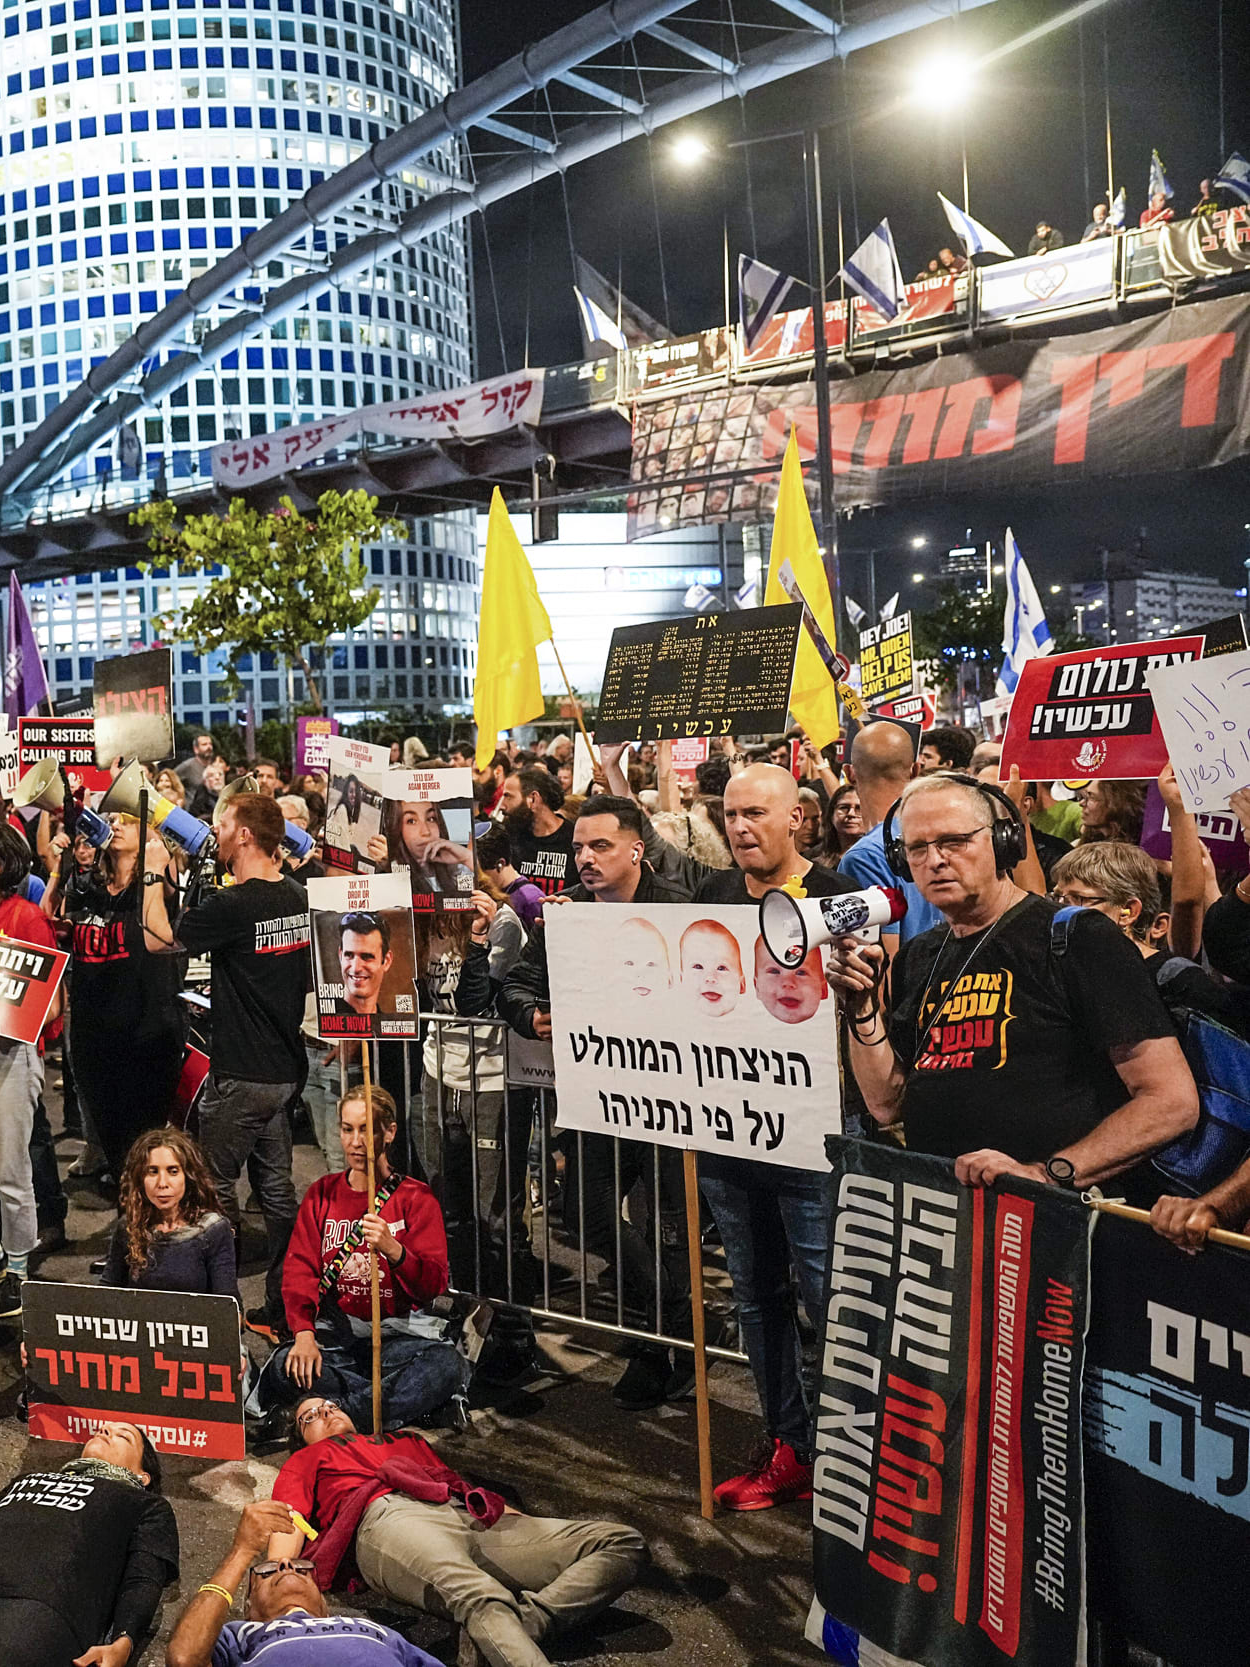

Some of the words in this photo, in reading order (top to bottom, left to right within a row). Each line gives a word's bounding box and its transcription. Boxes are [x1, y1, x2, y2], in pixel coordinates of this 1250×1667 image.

[695, 615, 719, 629] את
[859, 624, 882, 650] HEY
[882, 612, 909, 640] JOE!
[860, 647, 878, 666] MR.
[879, 631, 910, 658] BIDEN
[861, 655, 892, 685] HELP
[893, 647, 911, 671] US
[95, 685, 166, 718] הצילו
[862, 680, 886, 698] SAVE
[885, 667, 912, 689] THEM!
[893, 698, 922, 716] עסקה
[1030, 702, 1133, 734] עכשיו!
[23, 728, 47, 742] OUR
[50, 728, 95, 742] SISTERS
[21, 749, 66, 762] CALLING
[69, 749, 92, 762] FOR
[318, 983, 344, 999] BRING
[319, 999, 336, 1014] HIM
[320, 1015, 345, 1031] HOME
[348, 1014, 372, 1031] NOW!
[569, 1025, 683, 1075] המוחלט
[691, 1041, 813, 1088] הניצחון
[598, 1089, 694, 1136] נתניהו
[701, 1103, 735, 1142] פי
[742, 1099, 786, 1151] על
[1002, 1213, 1024, 1258] מטה
[822, 1173, 895, 1395] מחזירים
[889, 1182, 959, 1375] הביתה
[55, 1313, 139, 1343] שבויים
[996, 1260, 1020, 1361] המשפחות
[145, 1321, 209, 1348] פדיון
[34, 1347, 141, 1394] מחיר
[153, 1351, 236, 1403] בכל
[991, 1362, 1015, 1446] להחזרת
[1034, 1278, 1074, 1612] #BringThemHomeNow
[813, 1396, 877, 1552] אותם
[867, 1373, 948, 1593] עכשיו!
[988, 1446, 1010, 1534] החטופים
[986, 1536, 1007, 1633] והנעדרים
[258, 1628, 286, 1643] ON
[305, 1625, 384, 1642] AMOUR
